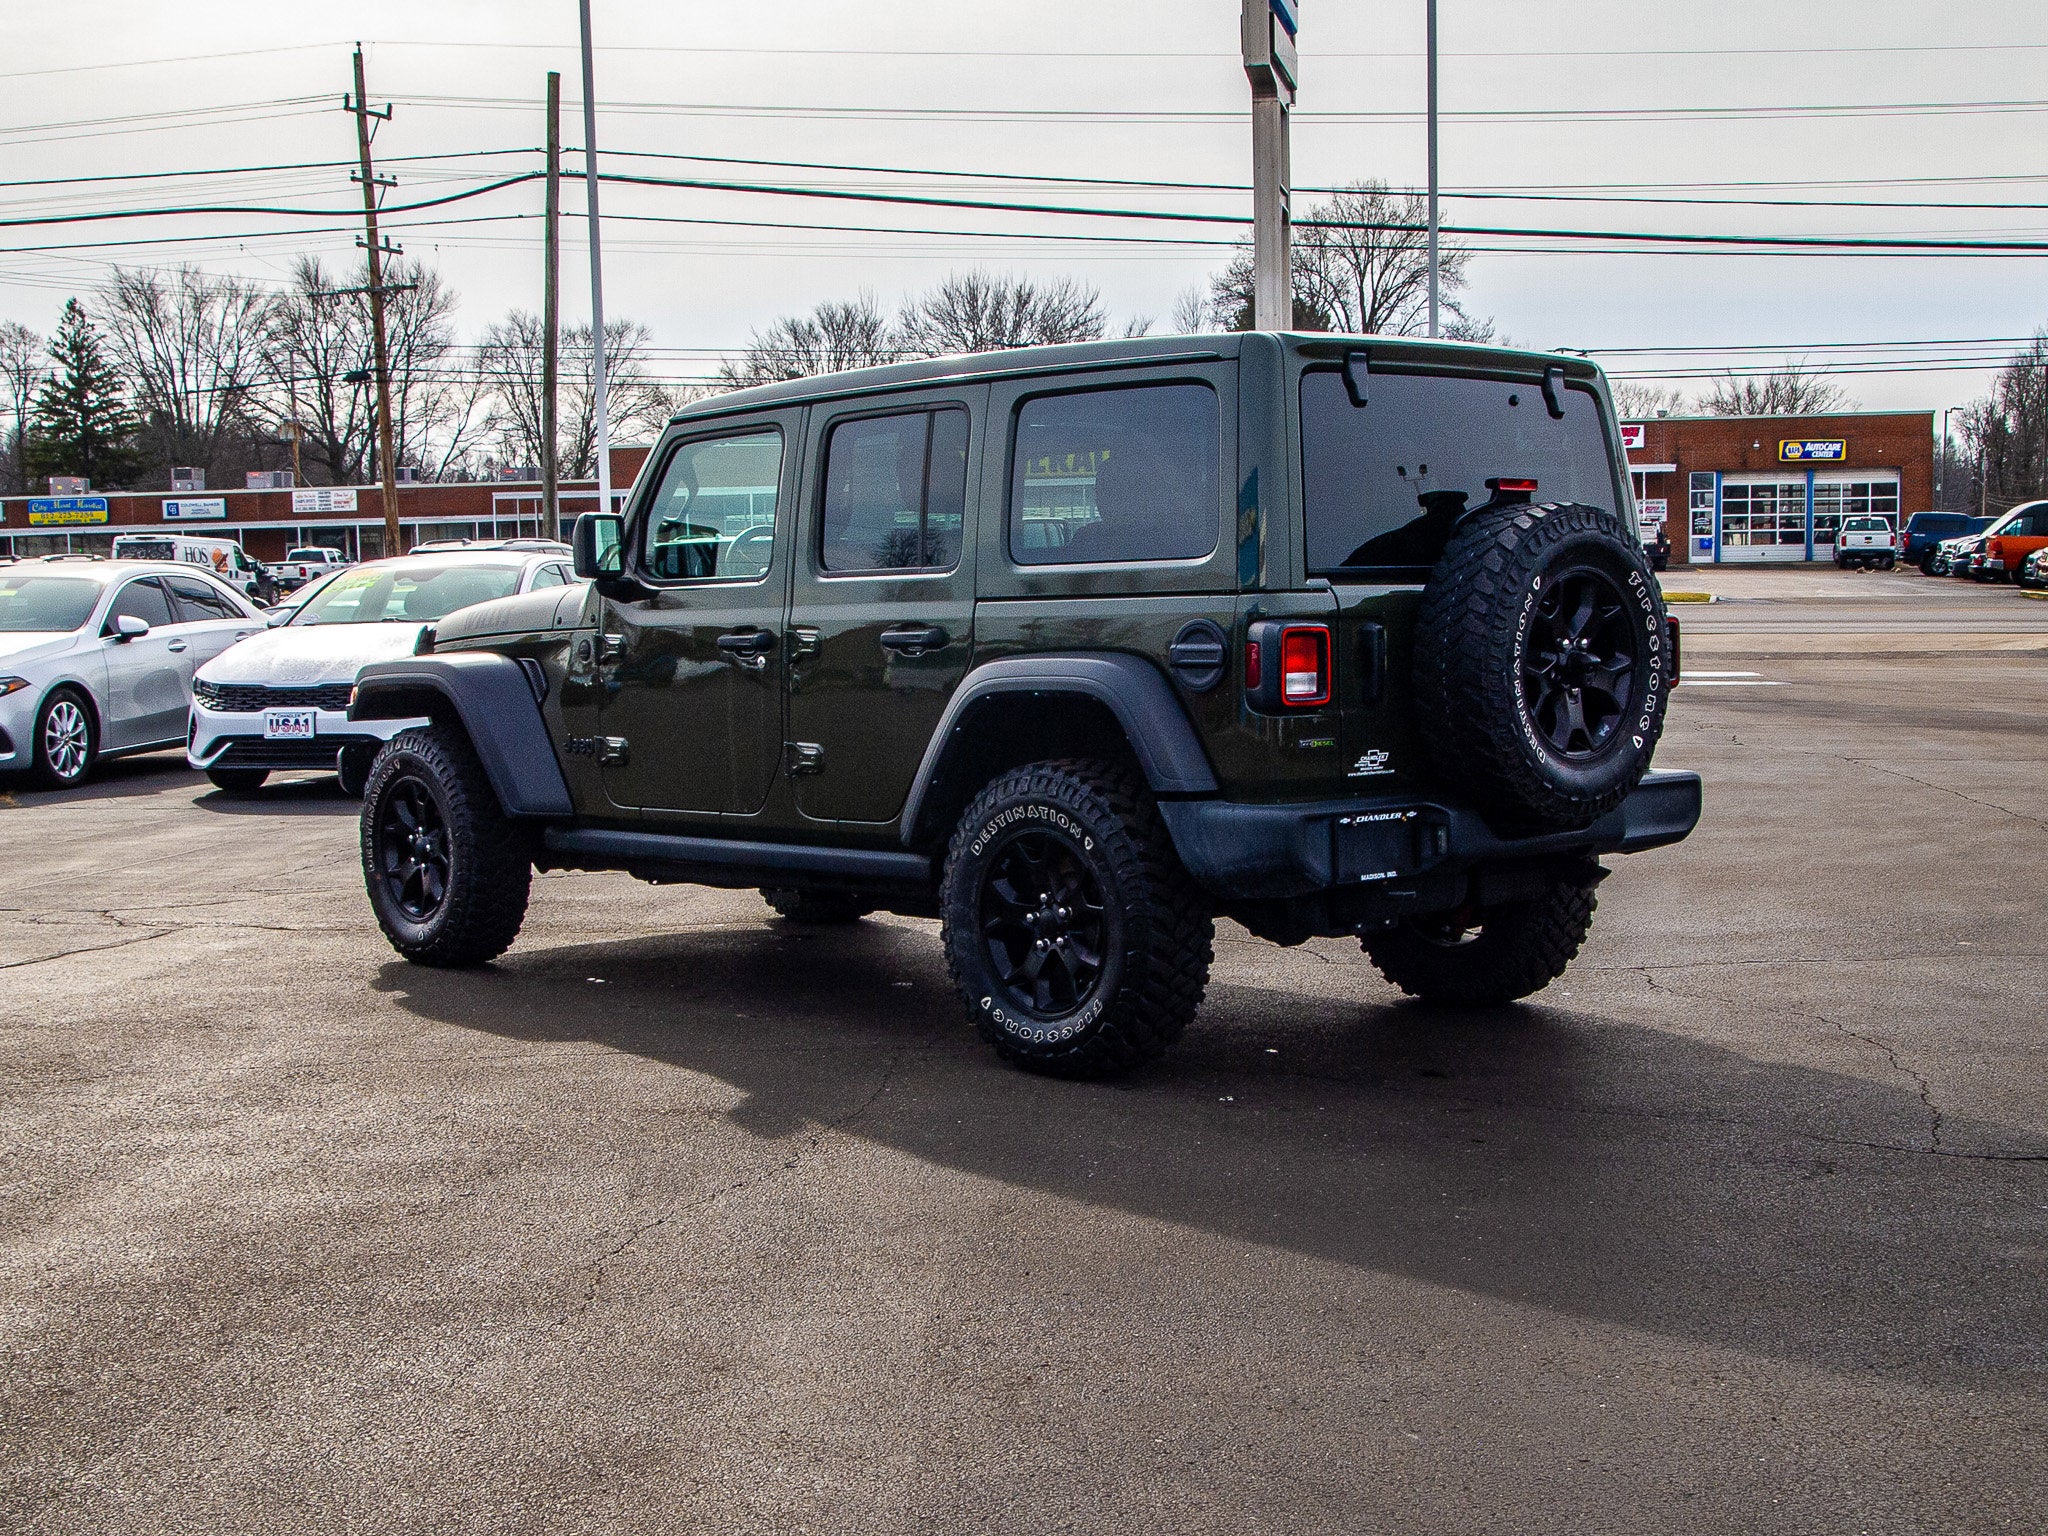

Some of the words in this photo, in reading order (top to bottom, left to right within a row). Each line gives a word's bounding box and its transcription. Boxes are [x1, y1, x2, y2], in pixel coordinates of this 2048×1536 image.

[1513, 593, 1546, 764] DESTINATION
[971, 805, 1081, 856] DESTINATION
[1356, 812, 1402, 823] CHANDLER
